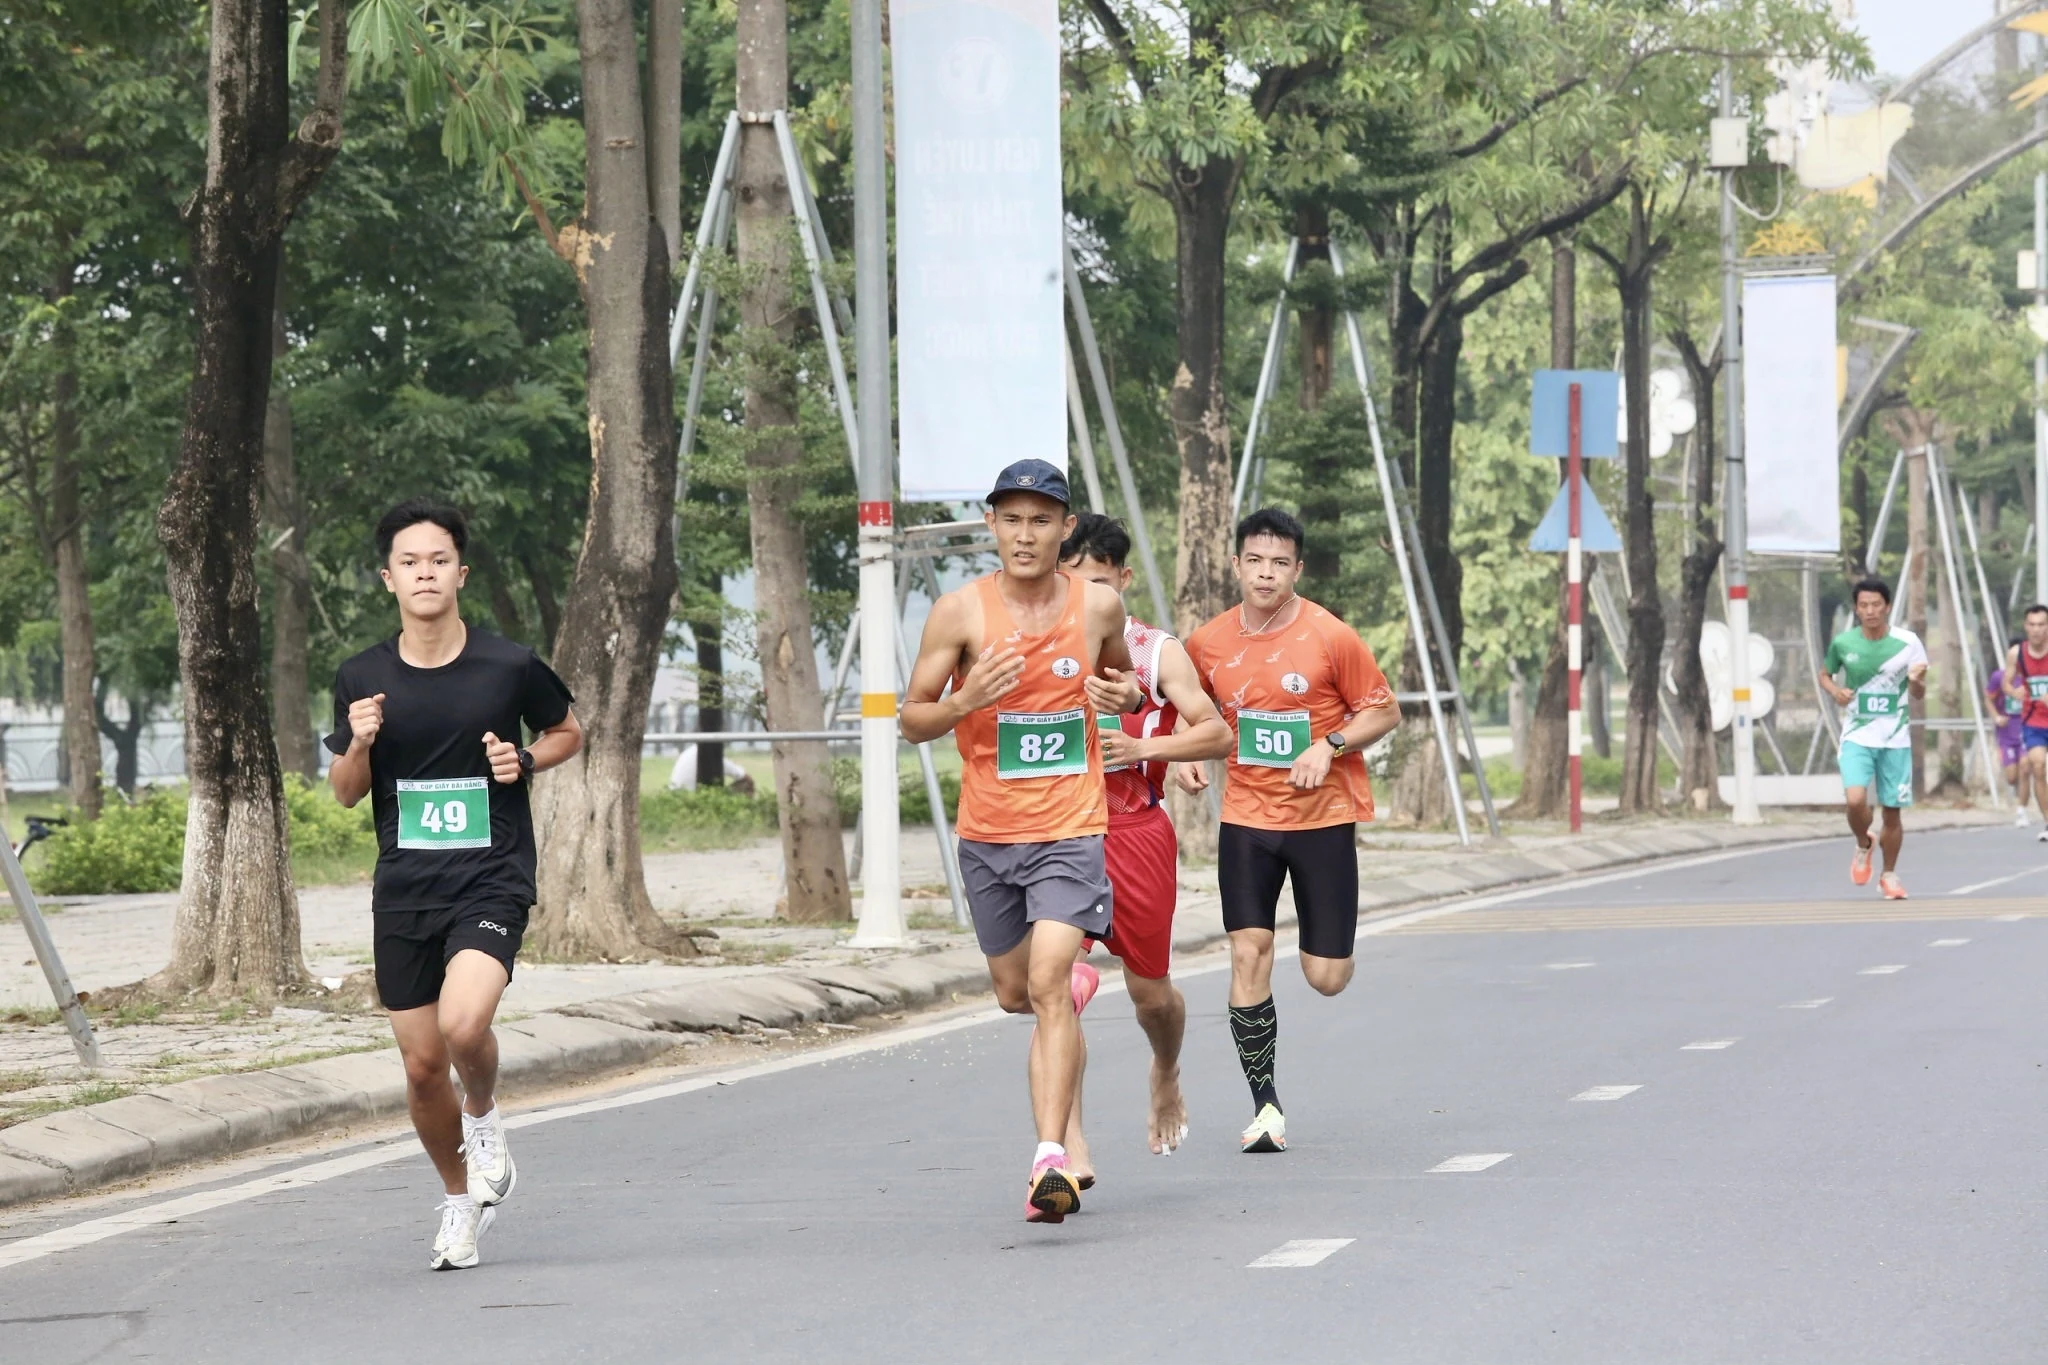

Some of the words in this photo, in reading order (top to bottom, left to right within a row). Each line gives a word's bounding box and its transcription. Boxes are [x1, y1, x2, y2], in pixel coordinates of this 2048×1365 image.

[1867, 696, 1889, 713] 02
[1019, 732, 1066, 763] 82
[1255, 728, 1293, 756] 50
[420, 800, 467, 833] 49
